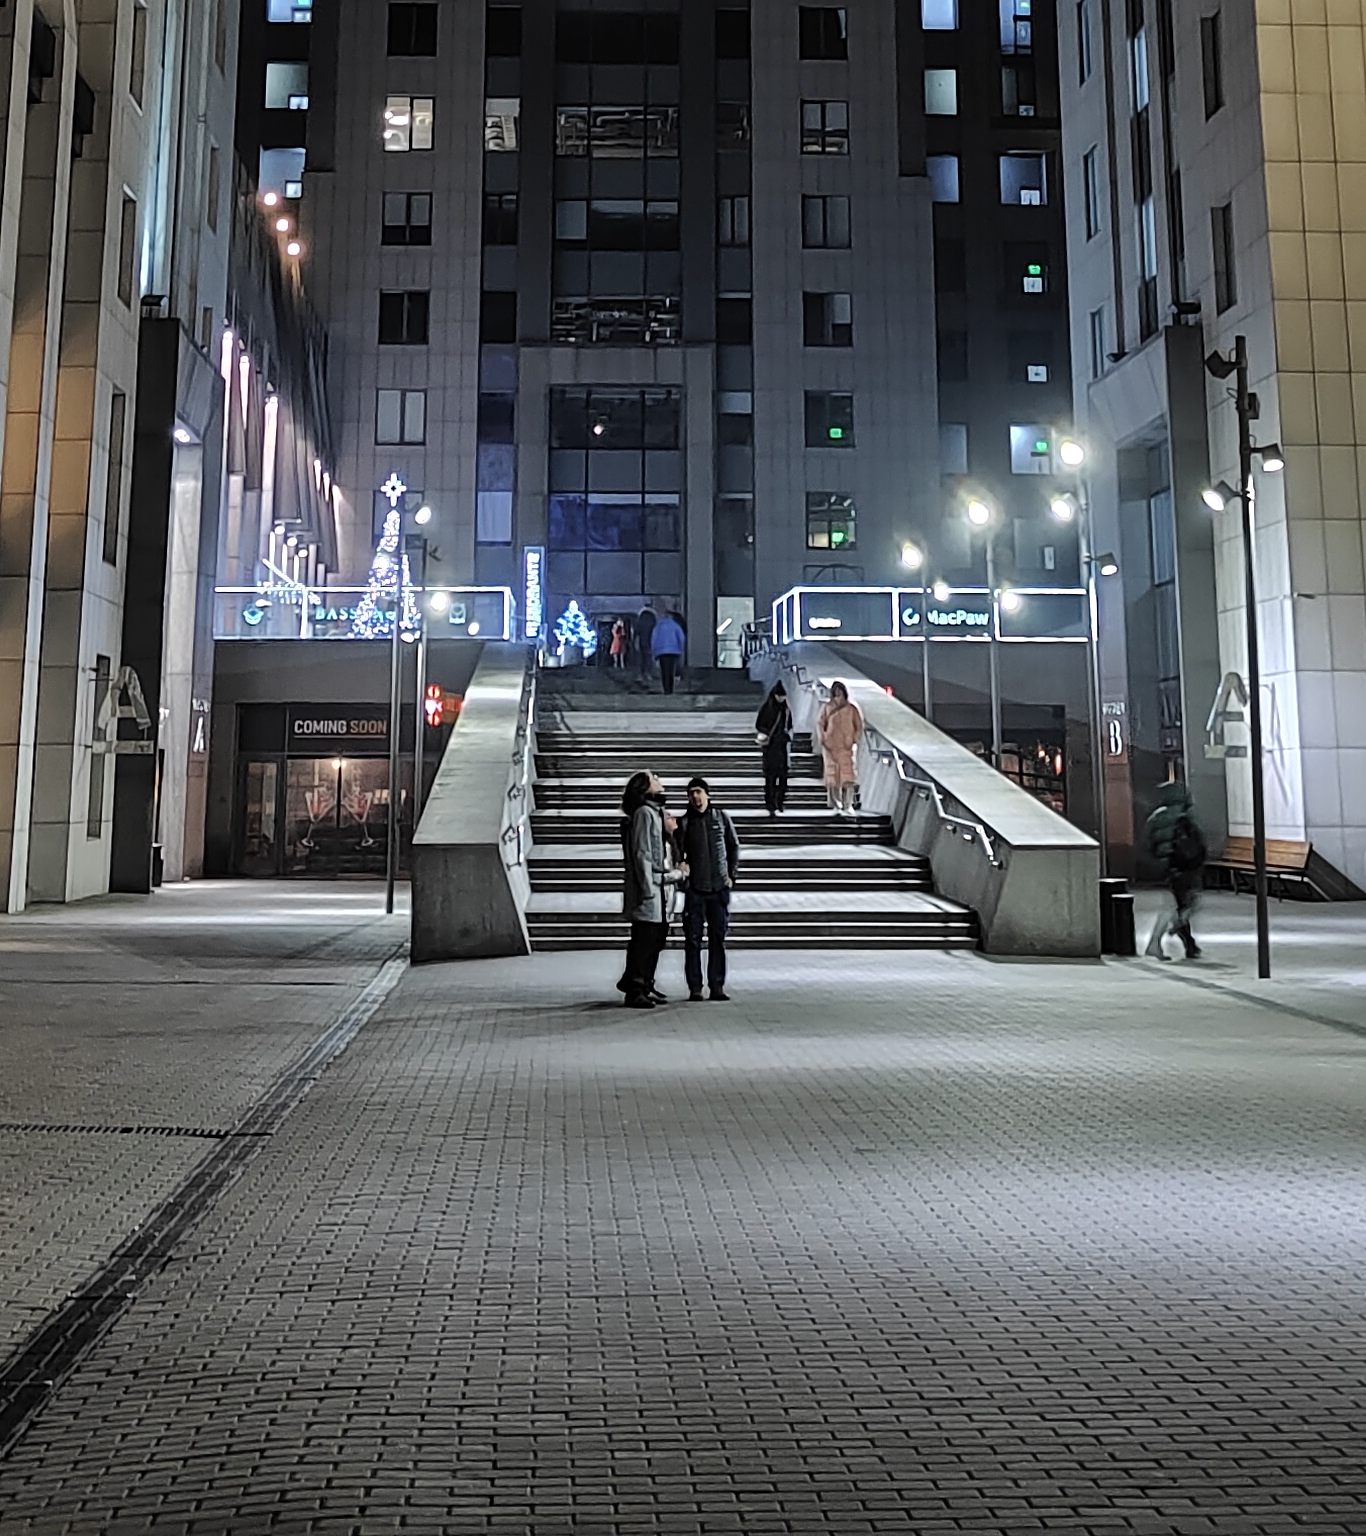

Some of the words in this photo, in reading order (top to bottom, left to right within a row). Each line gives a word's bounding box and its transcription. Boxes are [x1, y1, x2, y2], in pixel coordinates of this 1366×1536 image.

[928, 610, 989, 625] MacPaw
[294, 720, 347, 734] COMING
[350, 720, 387, 734] SOON
